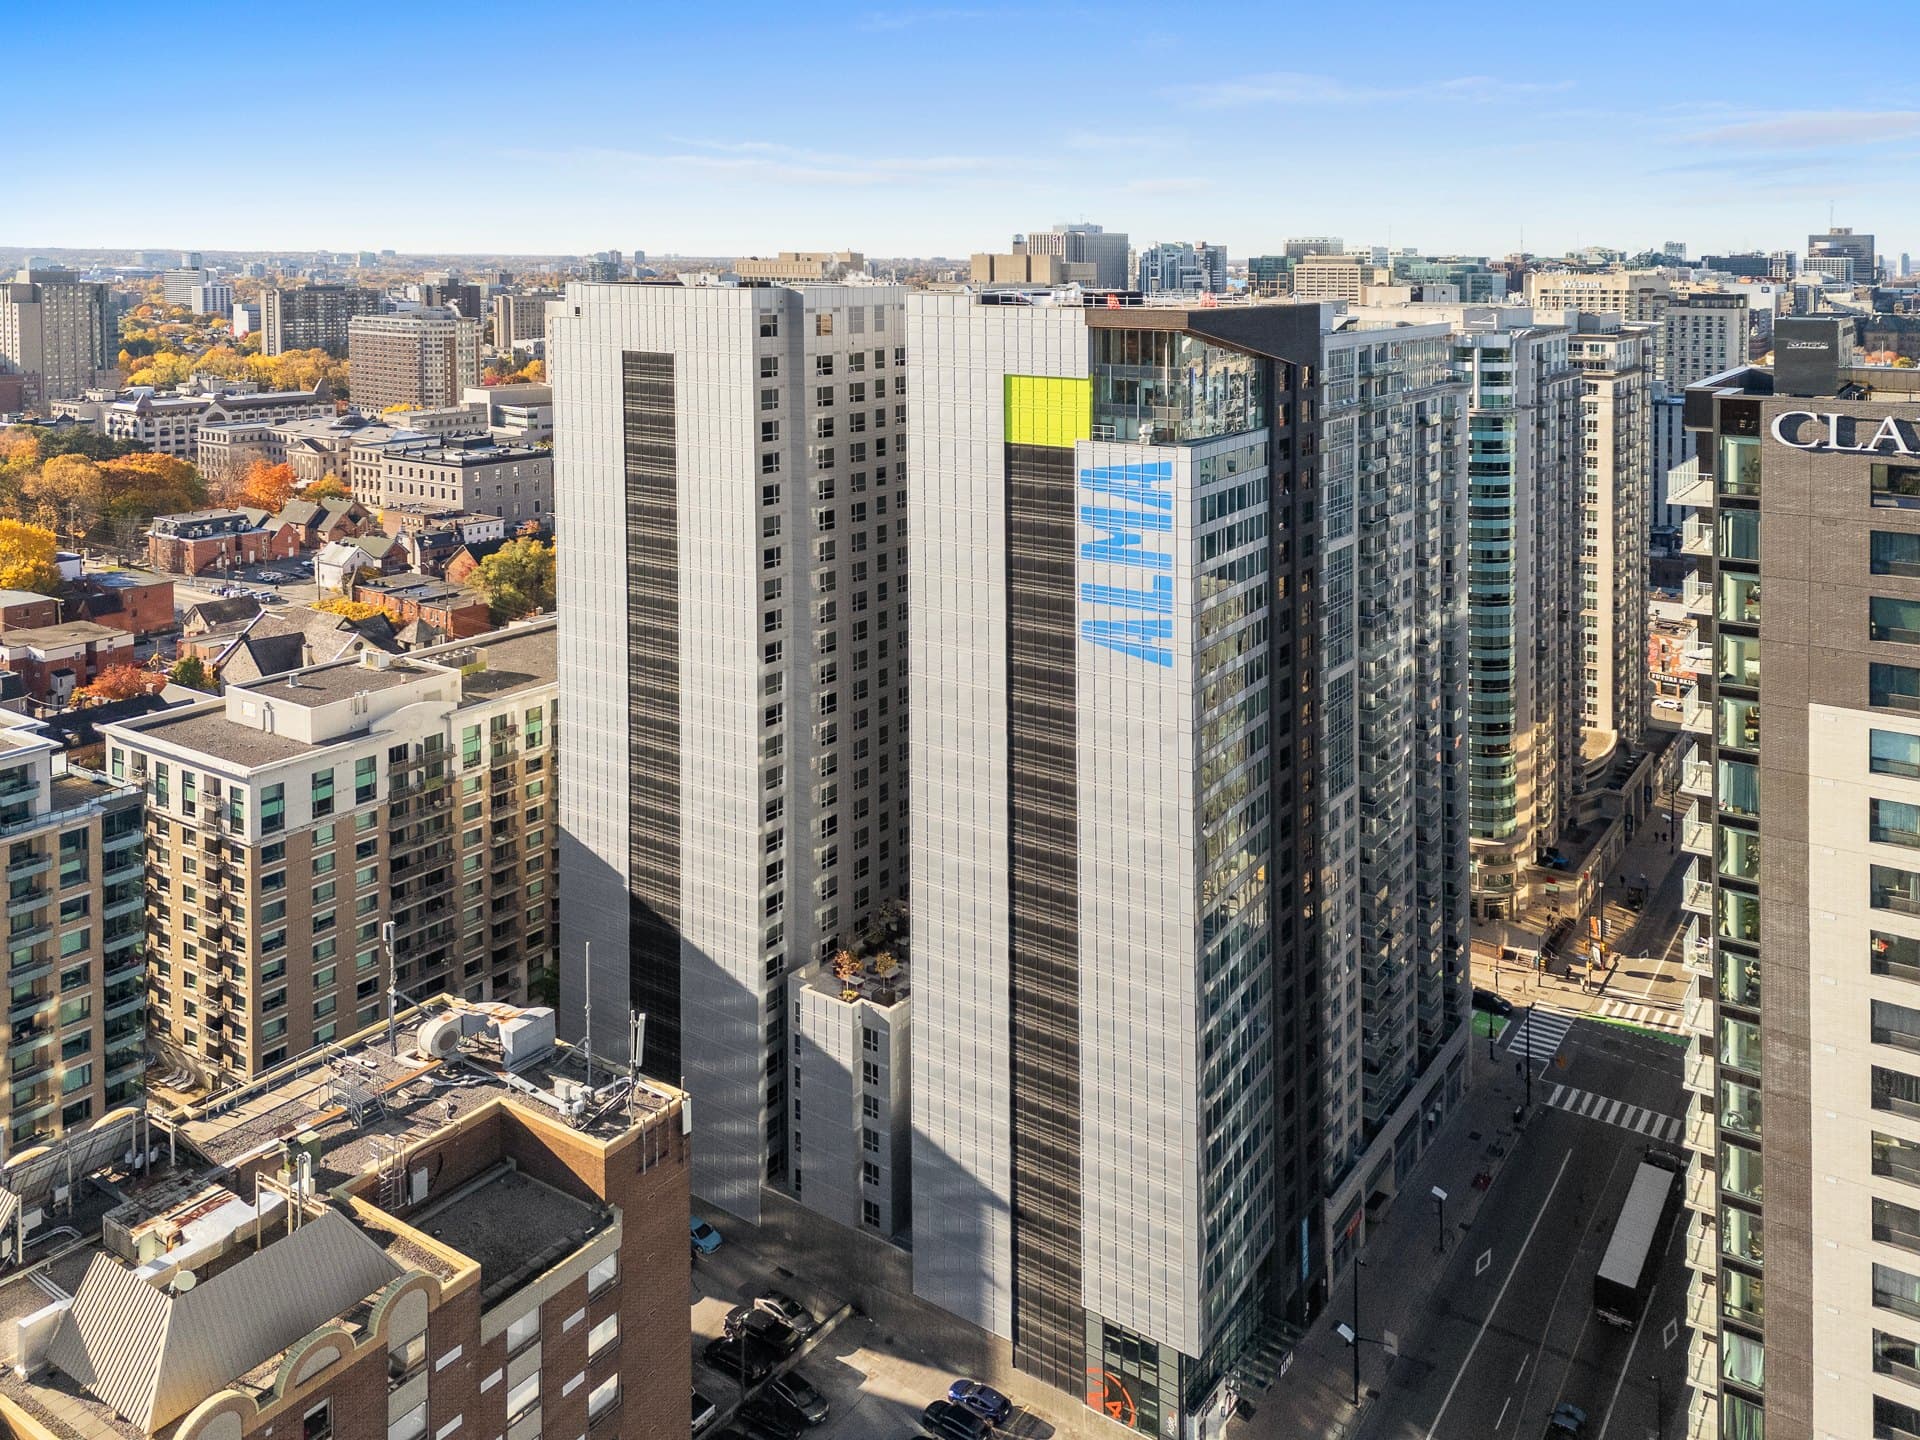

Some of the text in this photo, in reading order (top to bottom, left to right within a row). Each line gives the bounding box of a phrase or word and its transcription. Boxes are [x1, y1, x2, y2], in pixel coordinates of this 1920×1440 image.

[1771, 410, 1920, 455] CLA
[1081, 461, 1173, 667] ALMA
[1651, 673, 1678, 683] FUTURE
